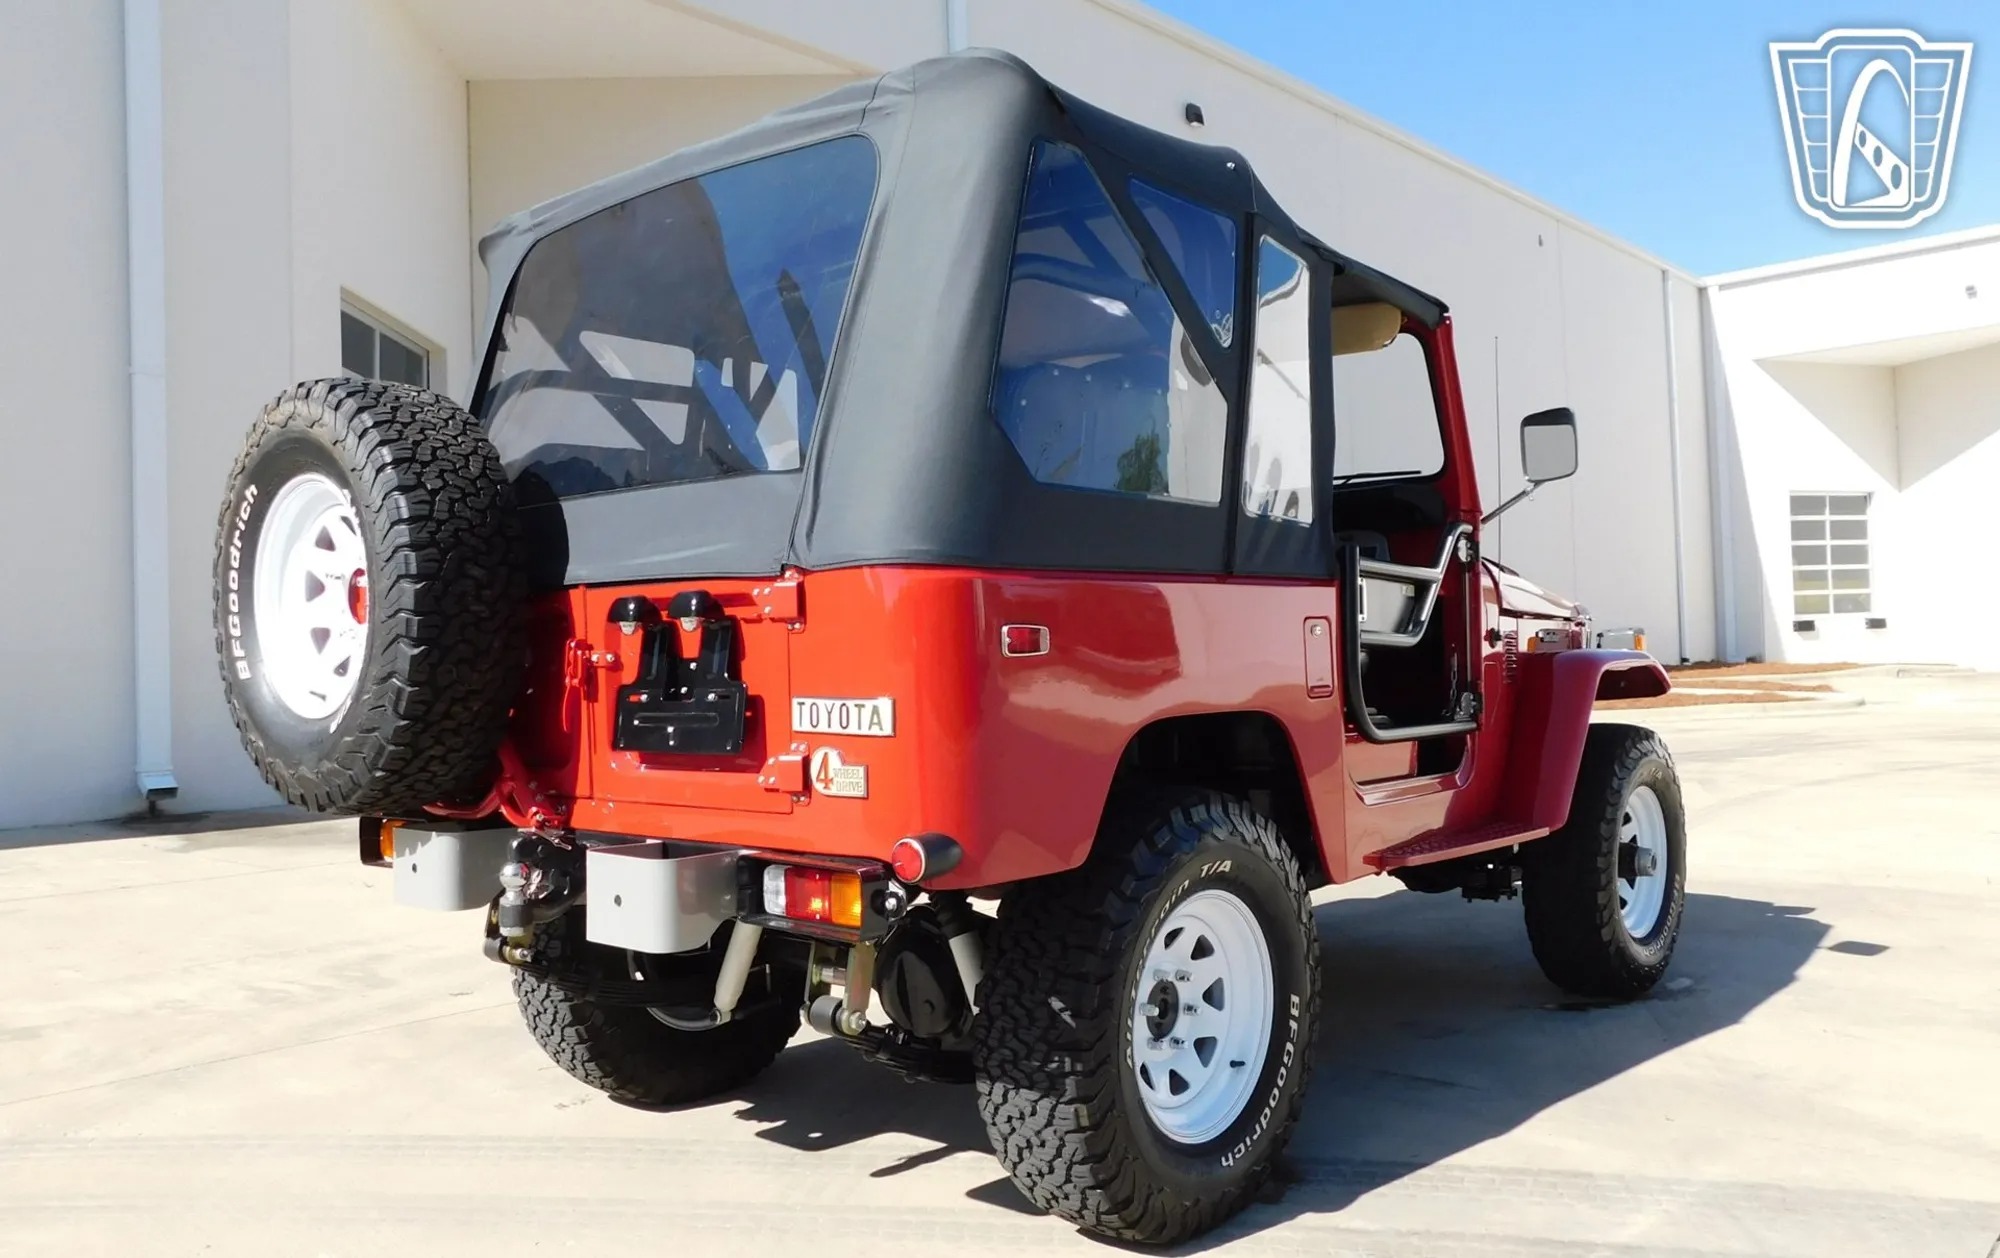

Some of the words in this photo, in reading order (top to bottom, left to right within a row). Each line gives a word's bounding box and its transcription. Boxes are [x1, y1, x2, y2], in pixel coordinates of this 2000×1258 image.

[228, 484, 259, 681] BFGoodrich
[796, 701, 884, 731] TOYOTA
[815, 751, 834, 791] 4
[832, 767, 863, 780] WHEEL
[835, 781, 863, 793] DRIVE
[1200, 860, 1232, 878] T/A
[1220, 993, 1300, 1168] BFGoodrich
